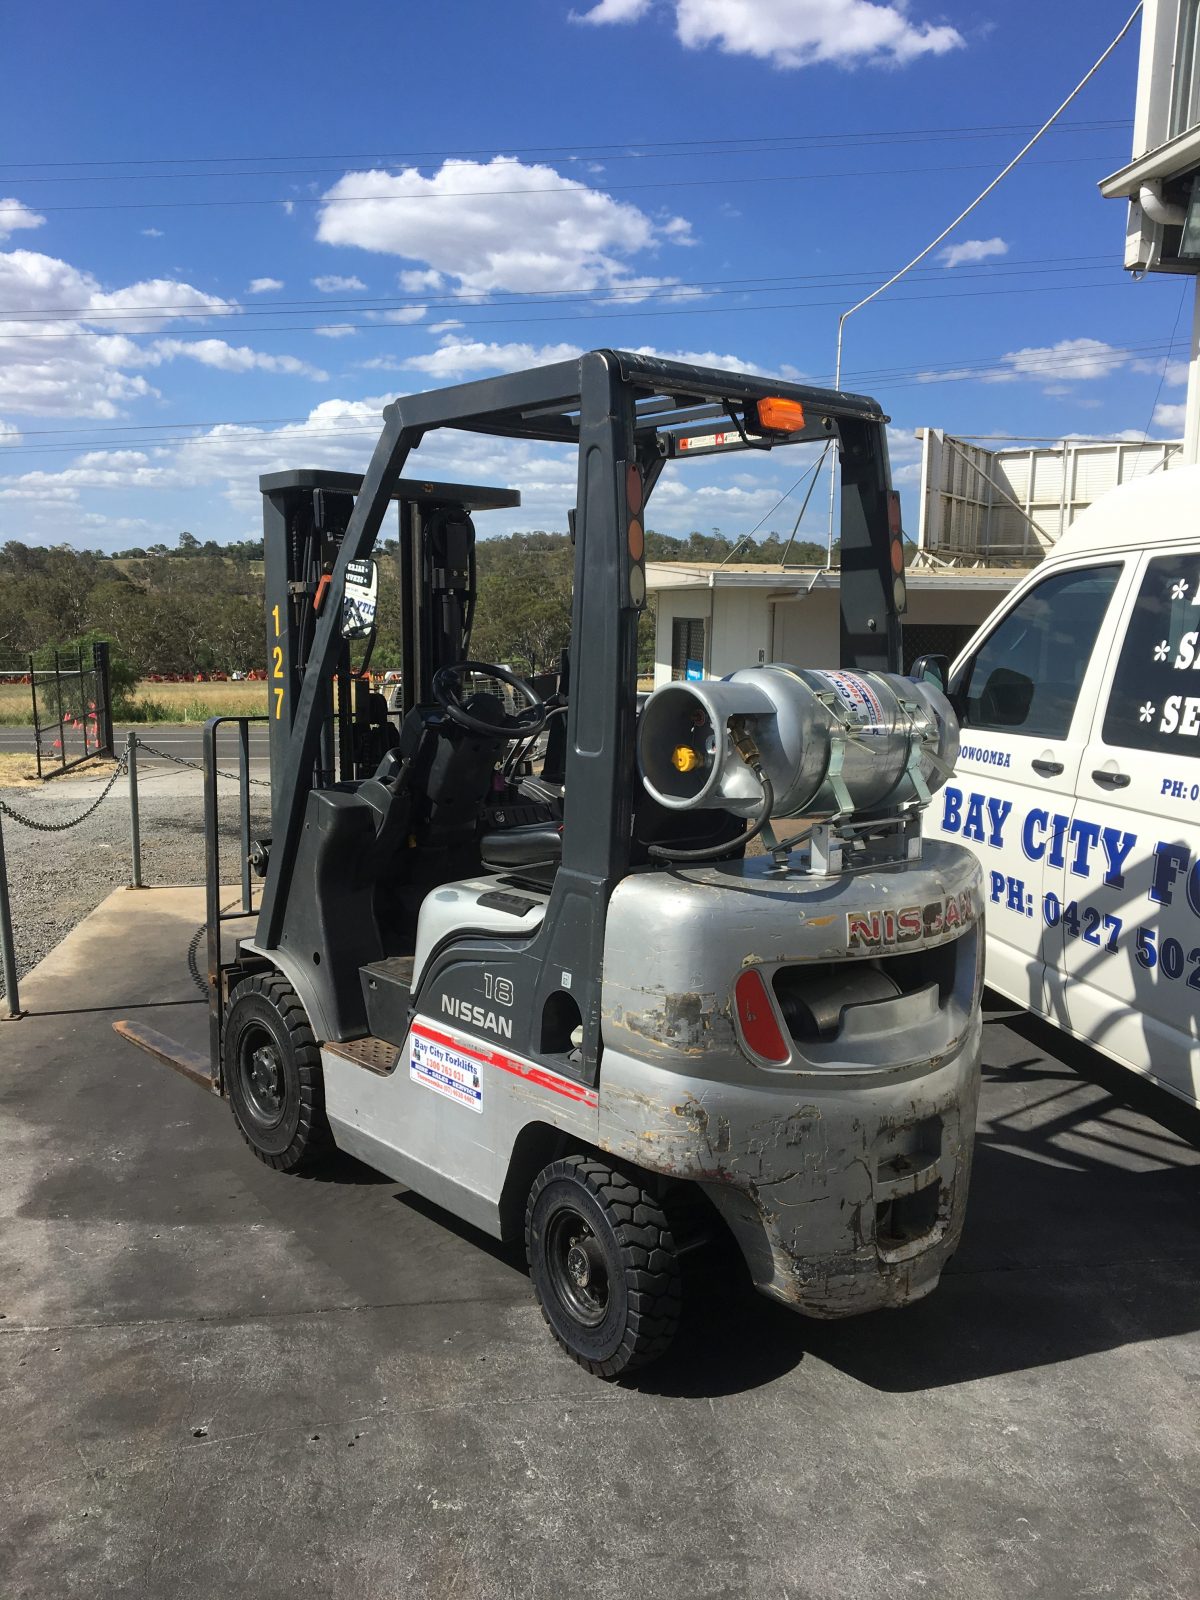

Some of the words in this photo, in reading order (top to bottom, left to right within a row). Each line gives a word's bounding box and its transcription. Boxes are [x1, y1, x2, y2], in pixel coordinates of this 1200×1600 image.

[1160, 778, 1188, 799] PH:
[941, 786, 1013, 849] BAY
[1021, 808, 1138, 892] CITY
[990, 870, 1034, 918] PH:
[1042, 891, 1123, 955] 0427
[484, 972, 514, 1007] 18
[441, 994, 513, 1039] NISSAN
[414, 1038, 428, 1055] Bay
[429, 1046, 445, 1062] City
[445, 1052, 478, 1075] Forklifts
